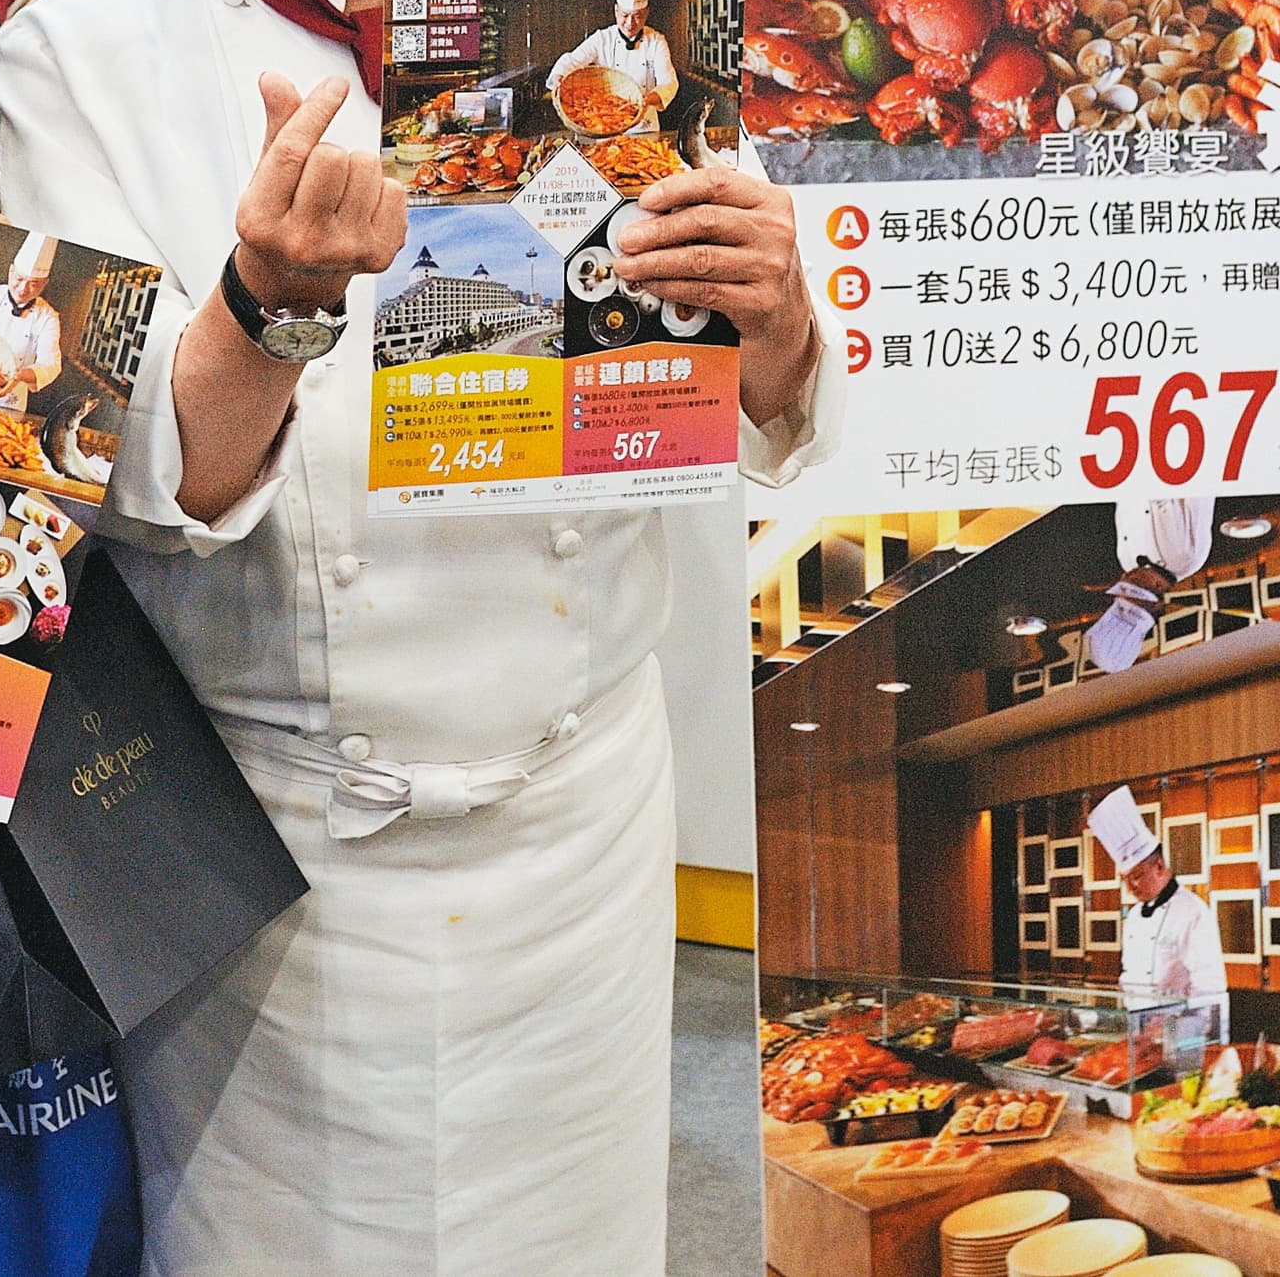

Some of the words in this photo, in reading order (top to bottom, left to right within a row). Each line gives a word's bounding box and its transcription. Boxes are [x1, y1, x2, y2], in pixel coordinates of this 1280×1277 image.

[1034, 128, 1230, 180] 星級饗宴
[555, 166, 579, 177] 2019
[408, 367, 529, 397] 聯合住宿券
[598, 356, 693, 386] 連鎖餐券
[885, 446, 1063, 489] 平均每張$
[1080, 370, 1277, 489] 567
[428, 438, 505, 477] 2,454
[613, 430, 661, 461] 567
